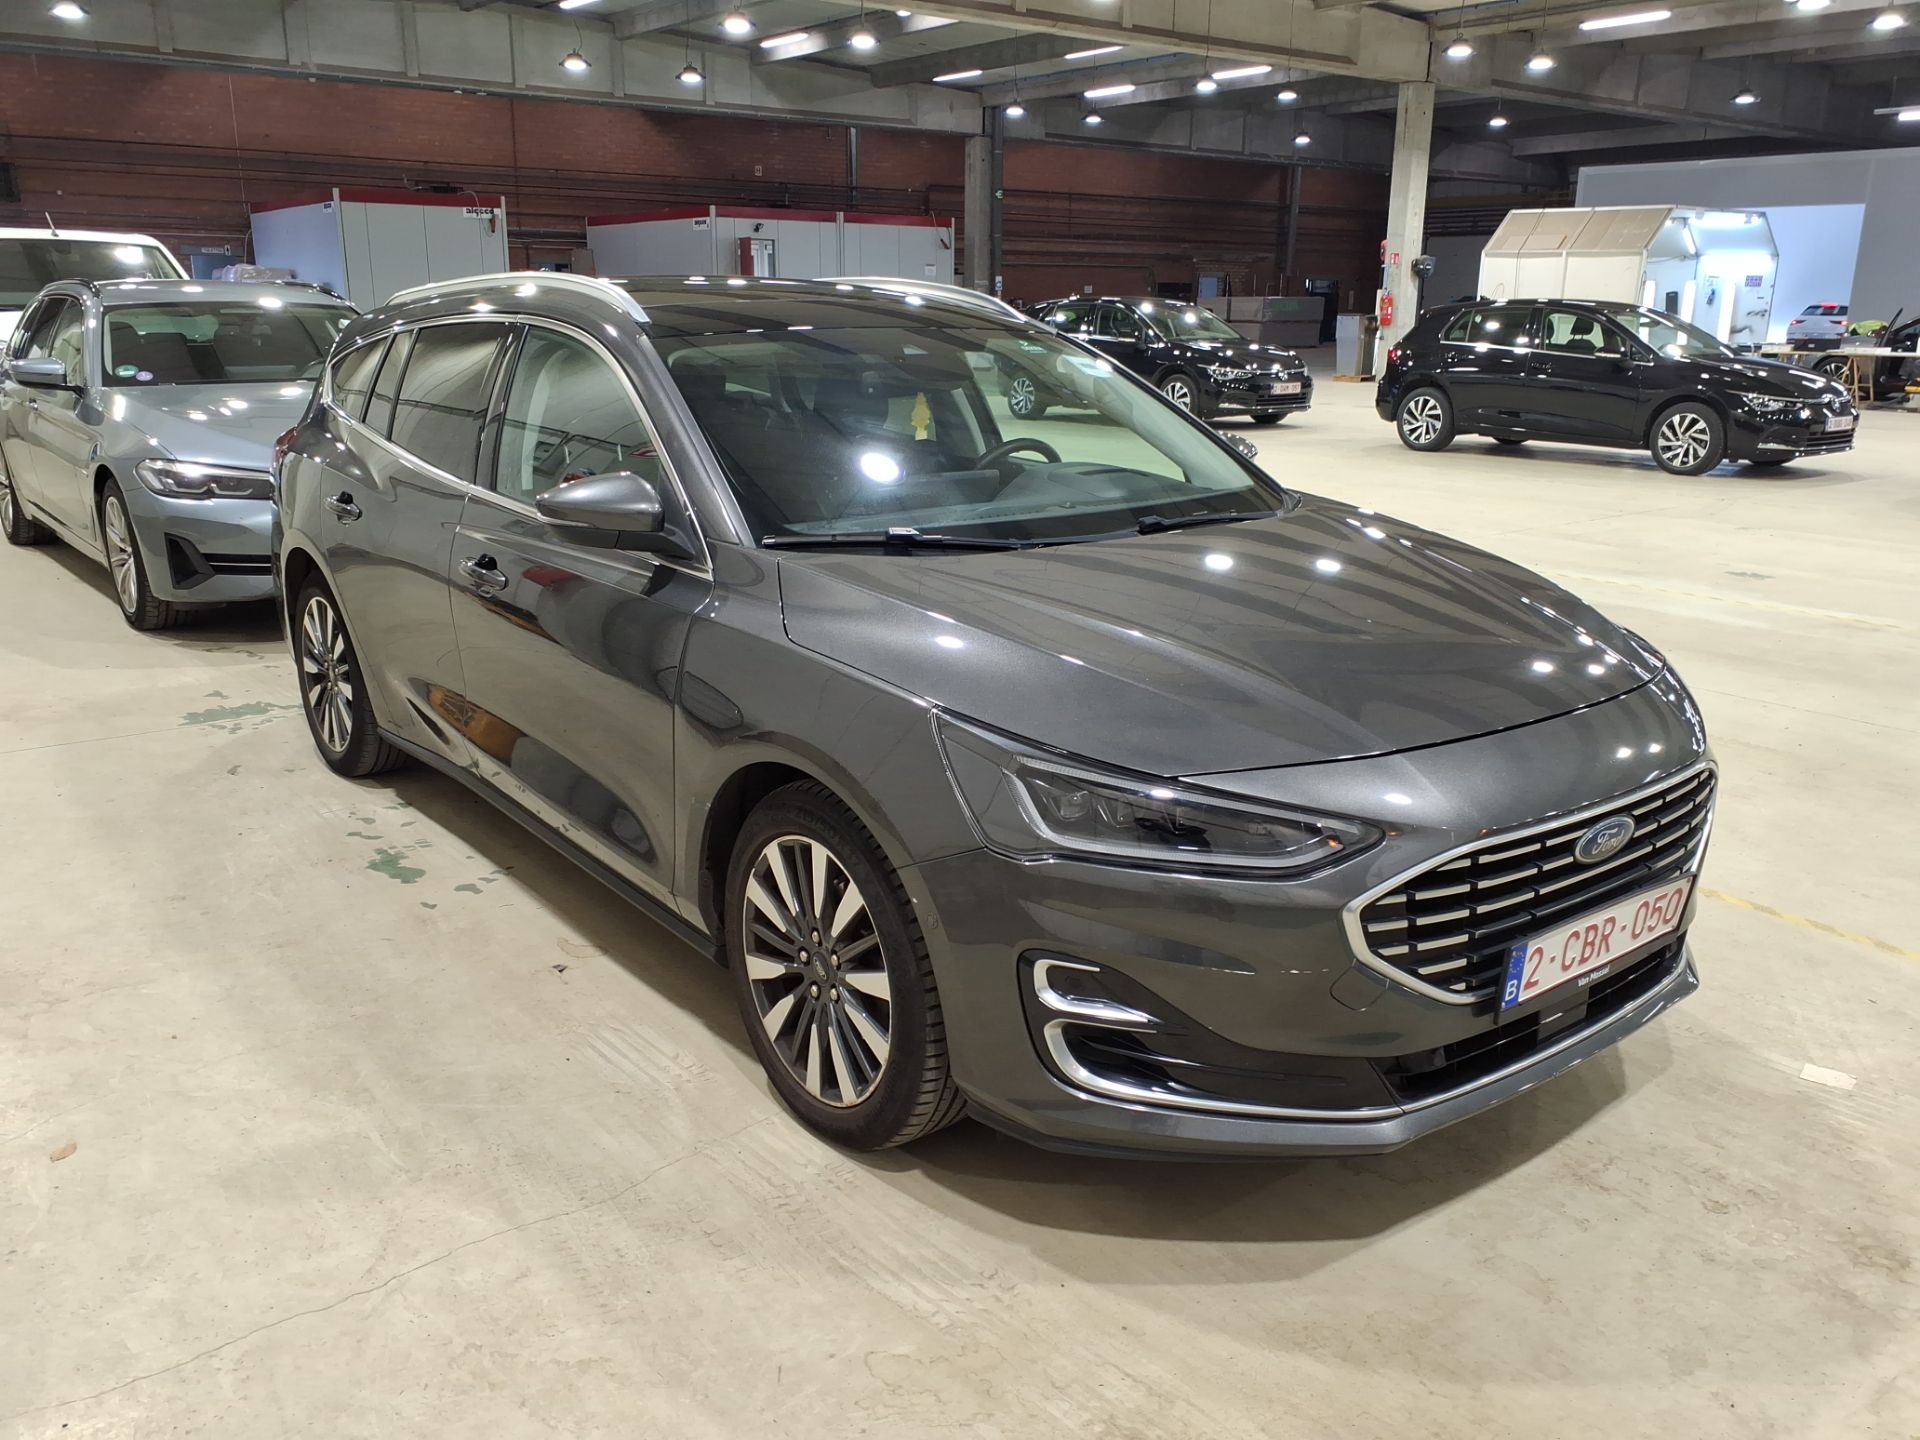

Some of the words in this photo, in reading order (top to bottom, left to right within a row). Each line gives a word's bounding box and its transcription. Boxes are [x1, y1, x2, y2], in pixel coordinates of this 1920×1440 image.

[1592, 827, 1625, 855] Ford
[1523, 887, 1683, 991] 2-CBR-050
[1505, 979, 1518, 1001] B
